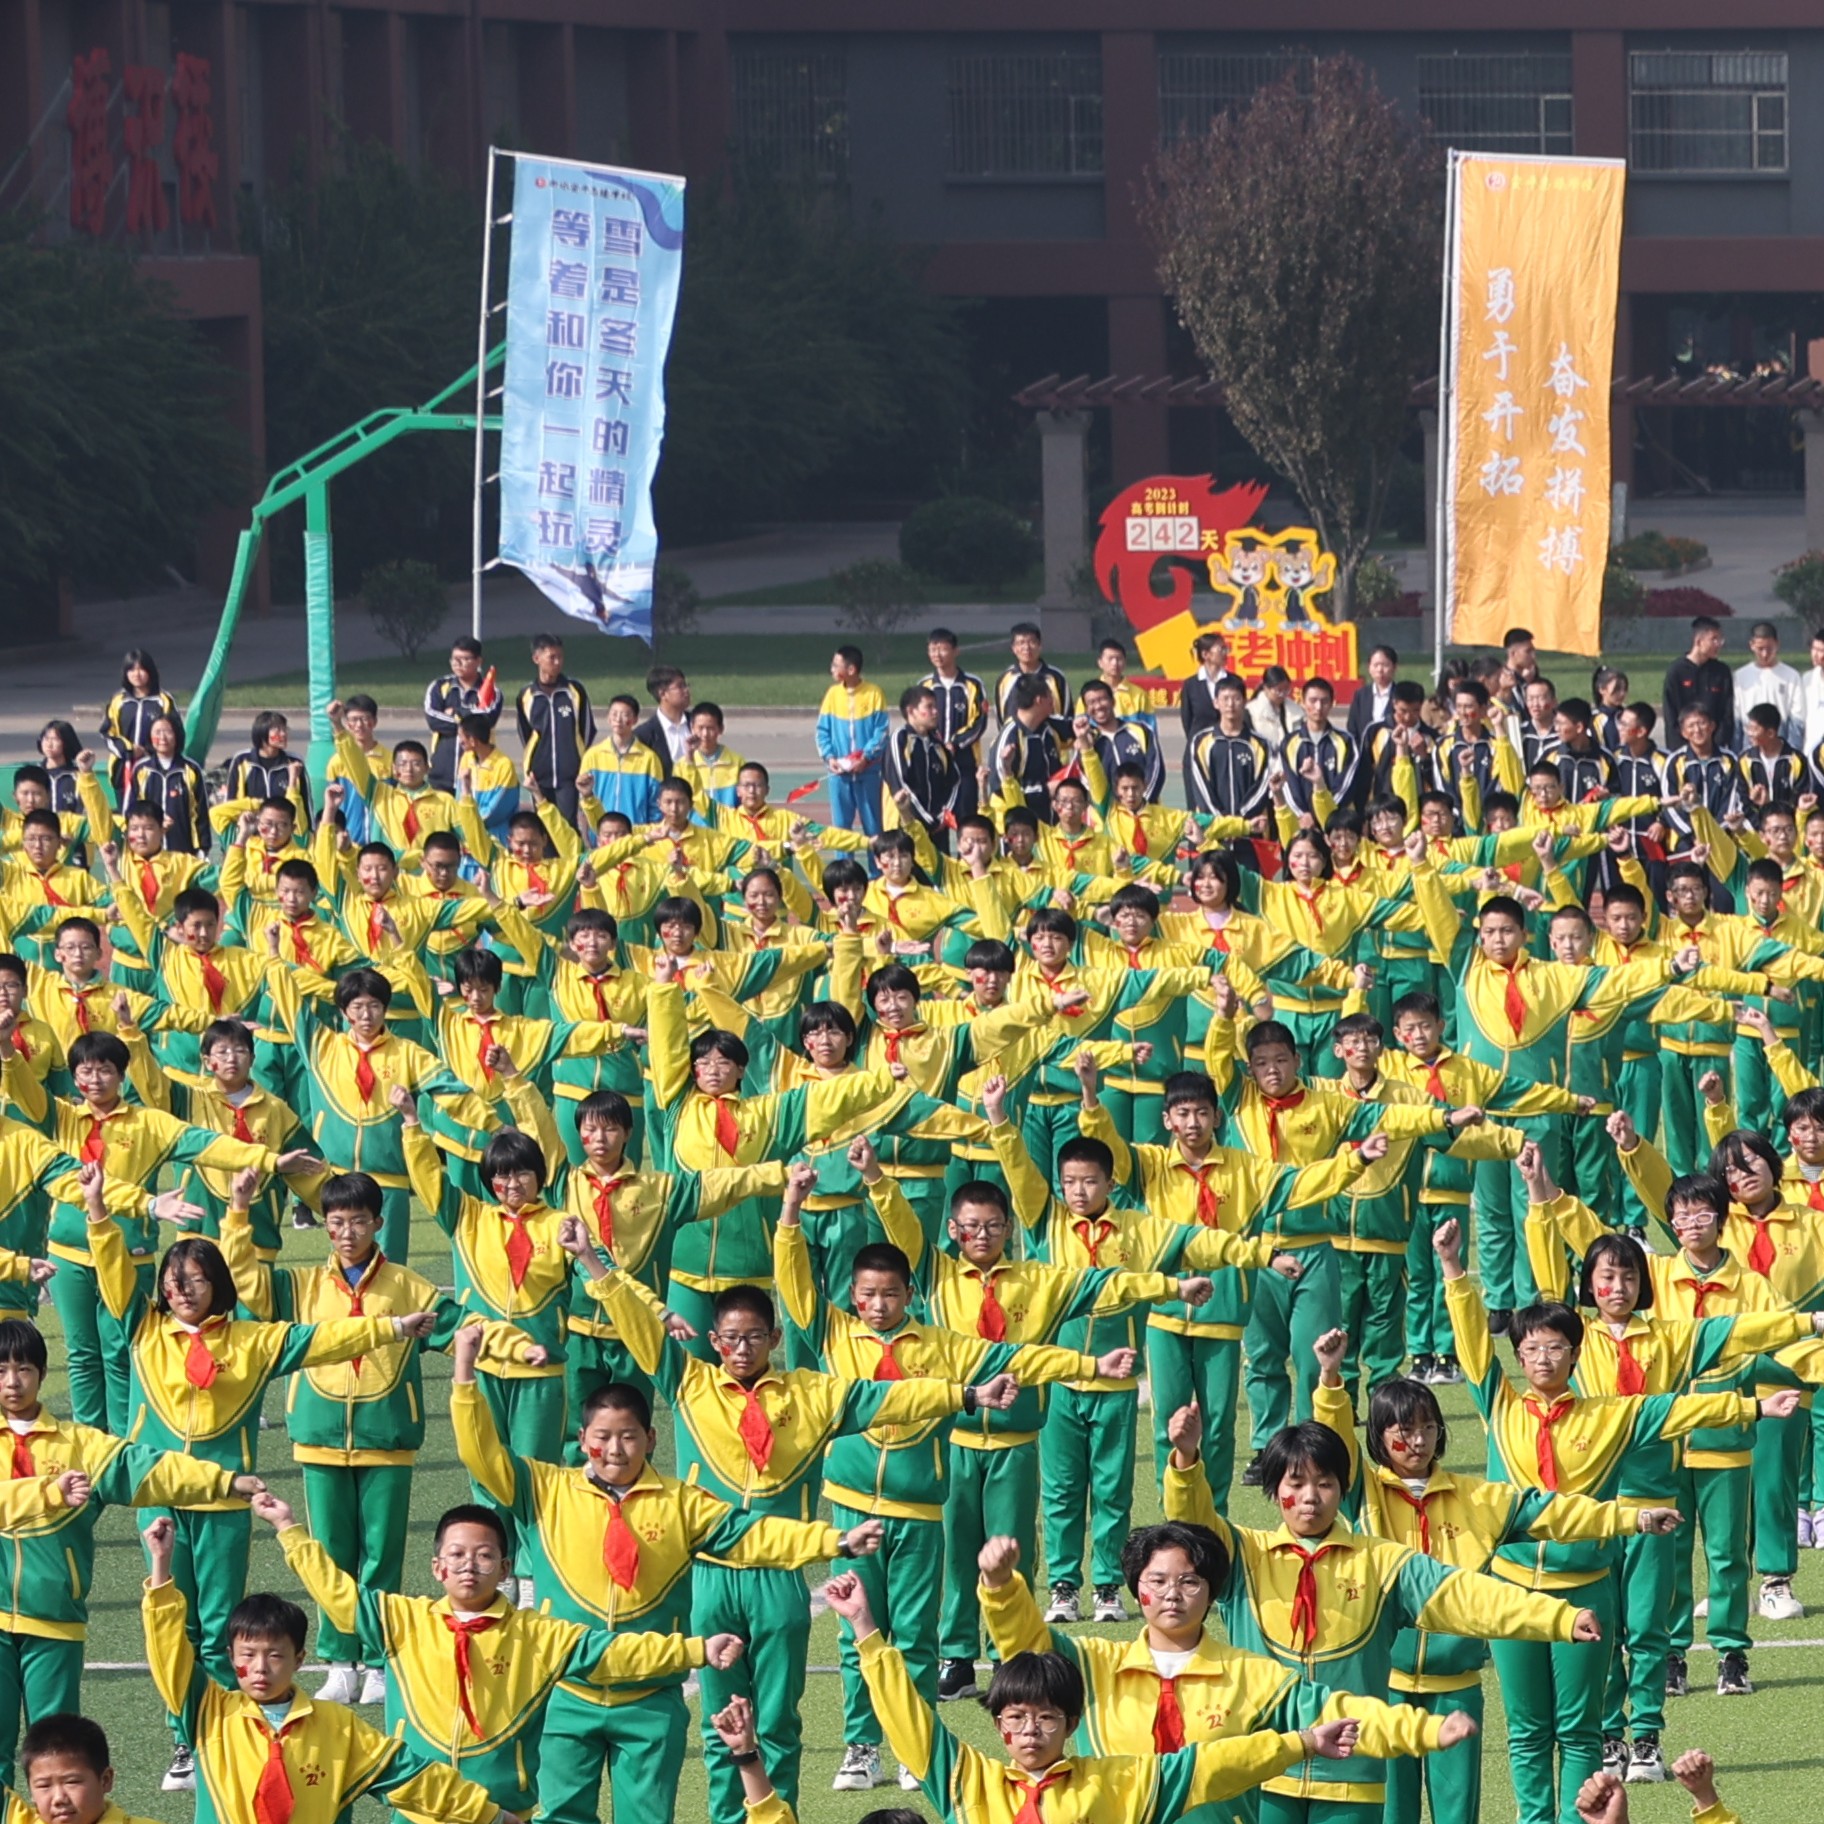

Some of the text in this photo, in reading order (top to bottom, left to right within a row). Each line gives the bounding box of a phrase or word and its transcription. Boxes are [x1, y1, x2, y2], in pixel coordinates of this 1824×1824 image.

[537, 208, 592, 550] 等着和你一起玩
[584, 215, 643, 556] 雪是冬天的精灵
[1144, 487, 1177, 501] 2023
[1479, 266, 1525, 498] 勇于开拓
[1538, 341, 1589, 576] 奋发拼搏
[1130, 522, 1219, 551] 242 天
